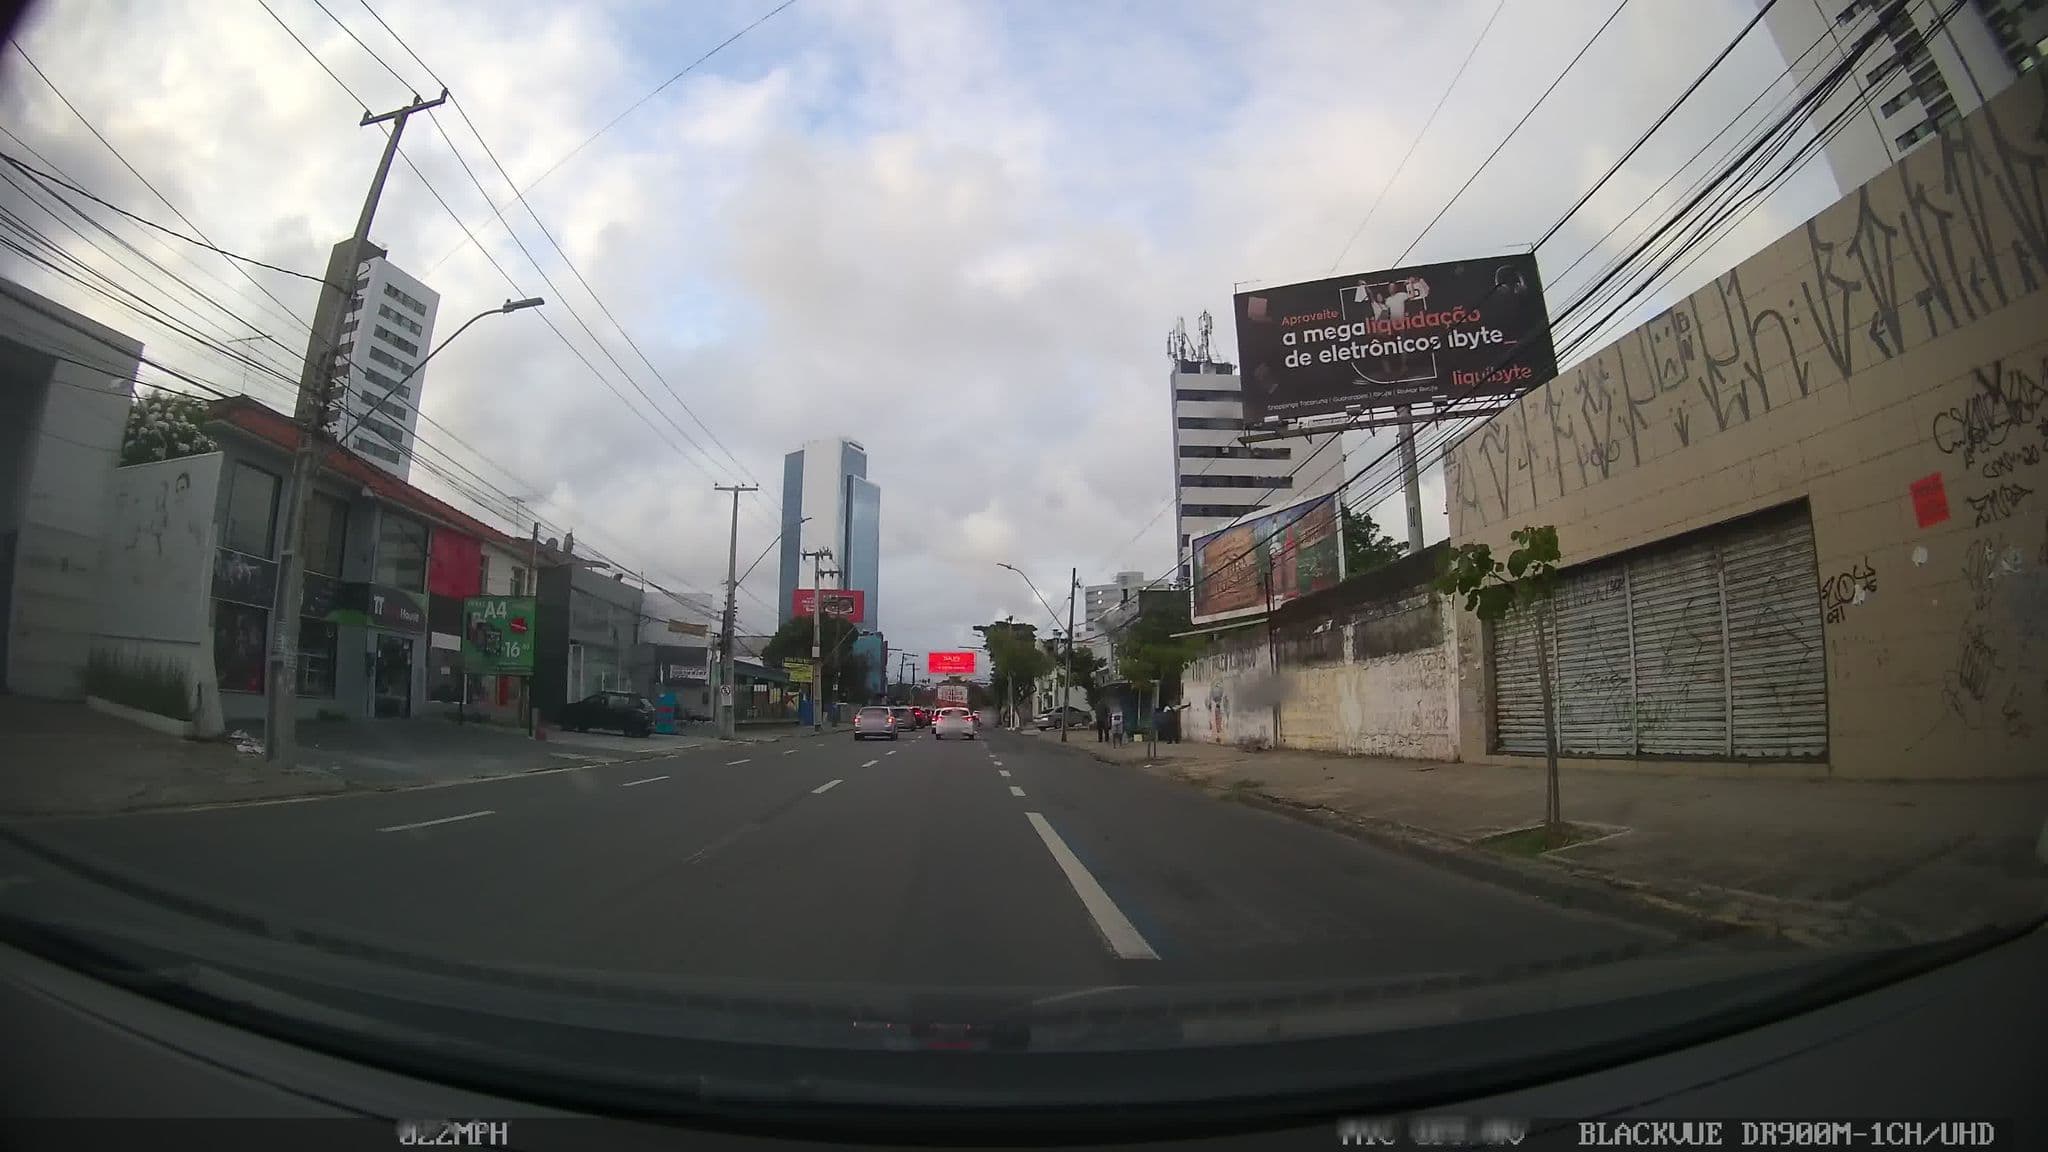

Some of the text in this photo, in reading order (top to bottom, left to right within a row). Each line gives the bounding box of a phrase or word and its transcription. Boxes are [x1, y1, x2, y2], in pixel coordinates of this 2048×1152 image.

[1282, 332, 1297, 346] a
[1284, 350, 1312, 368] de
[1318, 336, 1442, 363] eletrônicos
[484, 600, 507, 620] A4
[505, 641, 521, 658] 16
